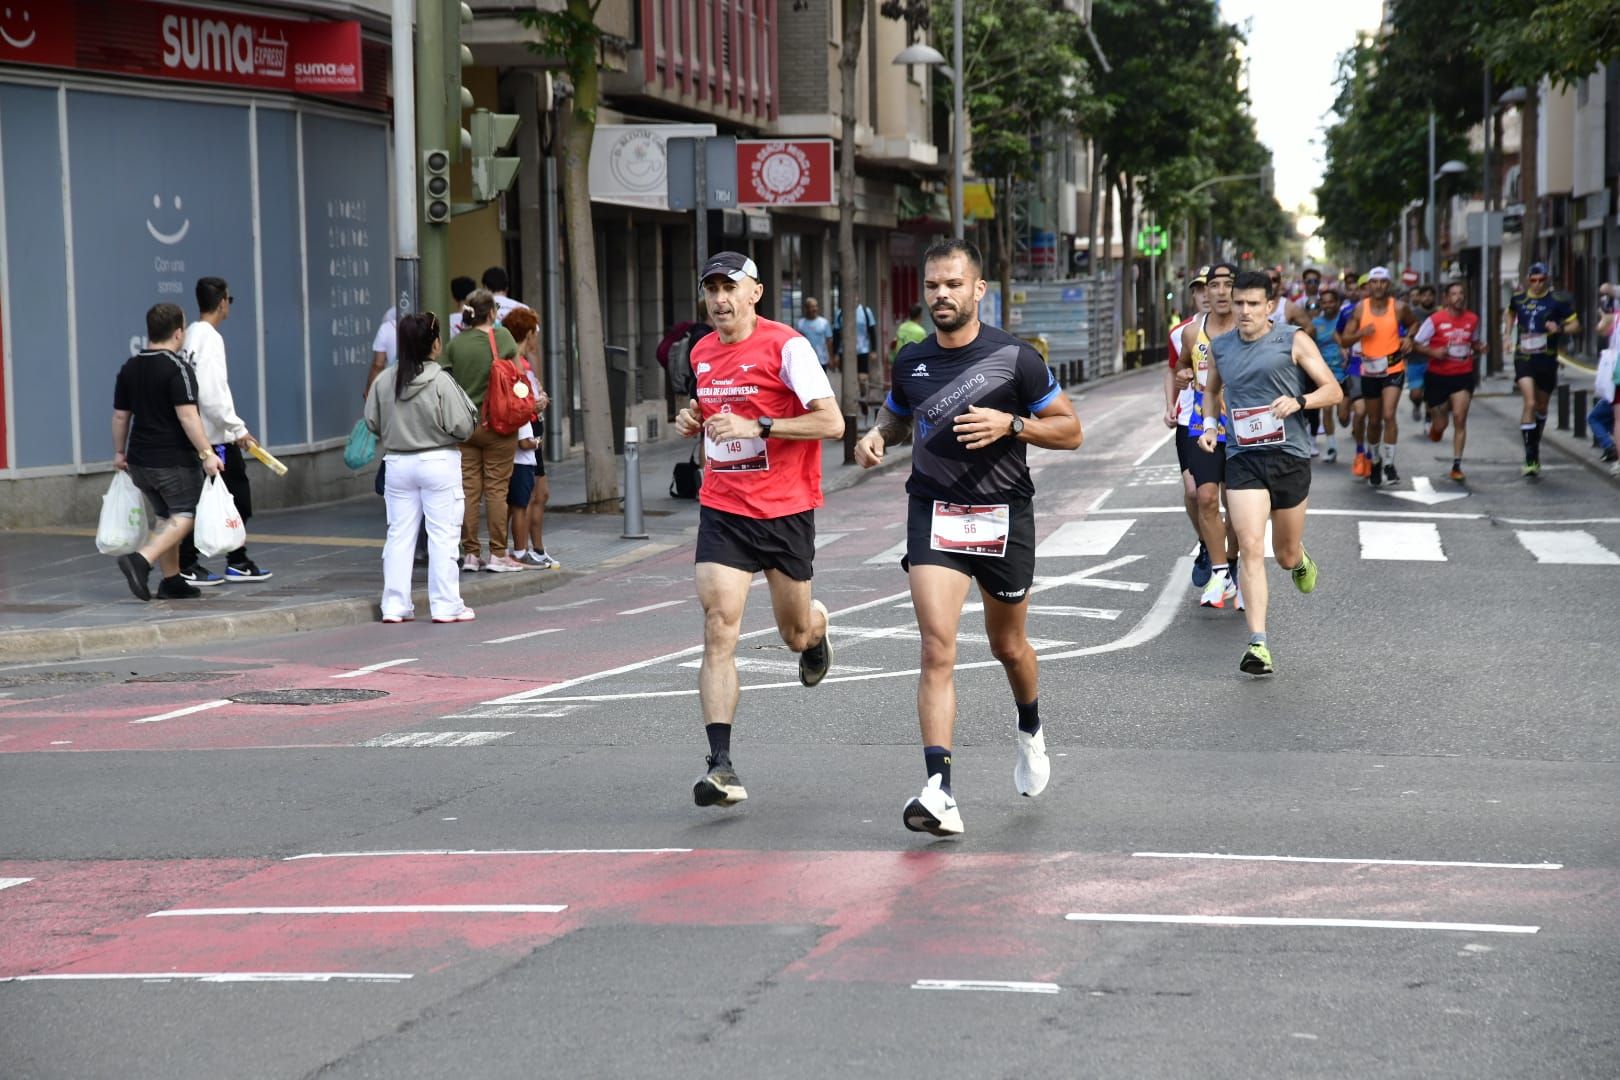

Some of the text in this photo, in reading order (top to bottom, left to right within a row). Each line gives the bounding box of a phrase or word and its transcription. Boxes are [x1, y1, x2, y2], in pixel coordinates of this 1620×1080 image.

[162, 14, 284, 75] suma EXPRESS
[294, 62, 337, 76] suma
[927, 373, 985, 419] AX-Training
[1249, 421, 1263, 433] 347
[726, 441, 742, 454] 149
[964, 523, 977, 534] 56
